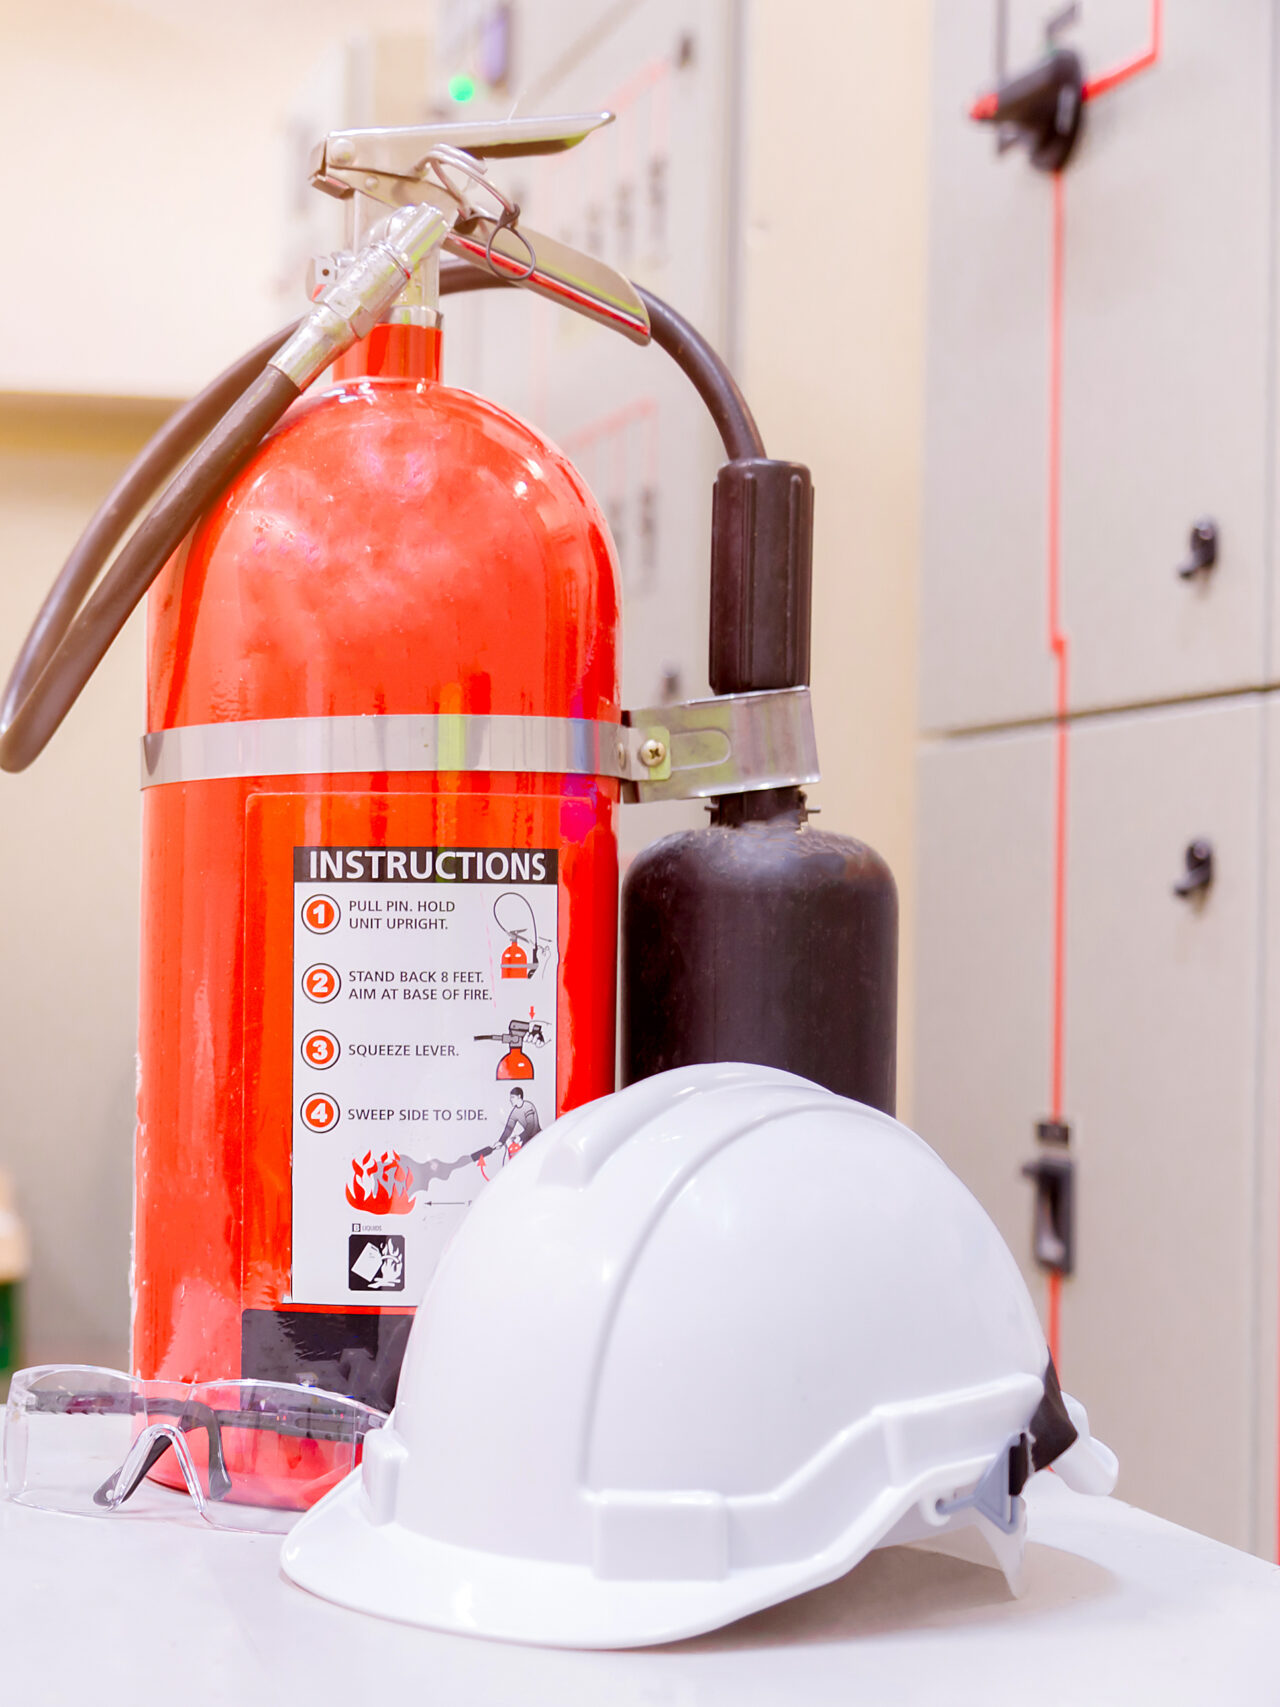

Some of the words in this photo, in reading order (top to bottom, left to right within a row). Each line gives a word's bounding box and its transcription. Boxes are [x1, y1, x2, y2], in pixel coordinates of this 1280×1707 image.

[309, 850, 546, 881] INSTRUCTIONS
[312, 903, 327, 925] 1
[349, 900, 383, 913] PULL
[386, 900, 413, 913] PIN.
[417, 900, 456, 913] HOLD
[349, 917, 383, 930] UNIT
[386, 917, 449, 930] UPRIGHT.
[312, 972, 329, 993] 2
[348, 970, 395, 983] STAND
[399, 970, 437, 983] BACK
[440, 970, 449, 983] 8
[453, 970, 485, 984] FEET.
[348, 988, 376, 1000] AIM
[380, 988, 399, 1001] AT
[402, 988, 438, 1001] BASE
[441, 988, 460, 1001] OF
[463, 988, 493, 1001] FIRE.
[311, 1040, 329, 1061] 3
[348, 1044, 411, 1058] SQUEEZE
[415, 1044, 460, 1057] LEVER.
[310, 1102, 328, 1123] 4
[347, 1108, 395, 1121] SWEEP
[399, 1108, 429, 1121] SIDE
[432, 1109, 452, 1121] TO
[456, 1108, 488, 1121] SIDE.
